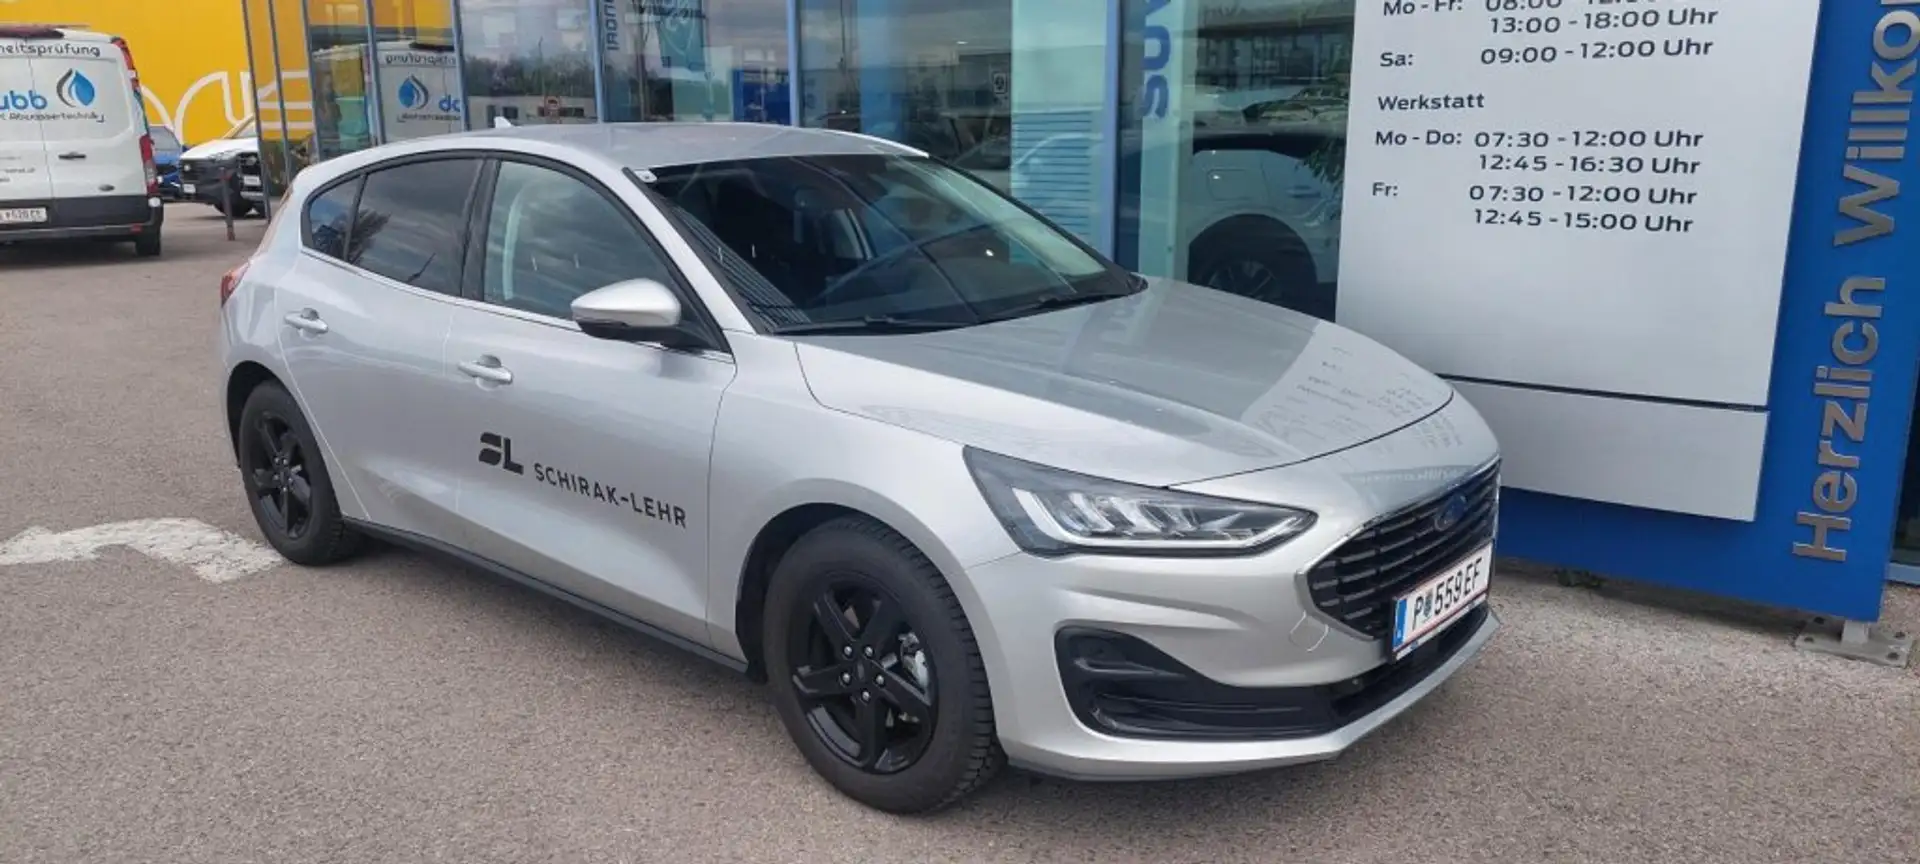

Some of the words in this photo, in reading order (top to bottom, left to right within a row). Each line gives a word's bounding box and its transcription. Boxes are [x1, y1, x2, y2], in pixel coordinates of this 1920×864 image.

[1491, 17, 1560, 33] 13:00
[1584, 10, 1659, 29] 18:00
[1668, 8, 1718, 26] Uhr
[1380, 52, 1413, 67] Sa:
[1481, 47, 1557, 65] 09:00
[1580, 40, 1655, 58] 12:00
[1663, 38, 1713, 56] Uhr
[1378, 94, 1485, 111] Werkstatt
[1833, 0, 1920, 247] Willko
[1375, 131, 1408, 146] Mo
[1426, 130, 1462, 146] Do:
[1475, 131, 1549, 148] 07:30
[1572, 130, 1646, 147] 12:00
[1654, 130, 1704, 148] Uhr
[1479, 154, 1548, 171] 12:45
[1569, 156, 1644, 174] 16:30
[1652, 156, 1701, 175] Uhr
[1372, 182, 1398, 197] Fr:
[1469, 184, 1545, 202] 07:30
[1568, 185, 1641, 203] 12:00
[1648, 186, 1698, 205] Uhr
[1474, 208, 1542, 227] 12:45
[1564, 212, 1637, 231] 15:00
[1645, 214, 1694, 233] Uhr
[1792, 276, 1886, 561] Herzlich
[533, 462, 687, 529] SCHIRAK-LEHR
